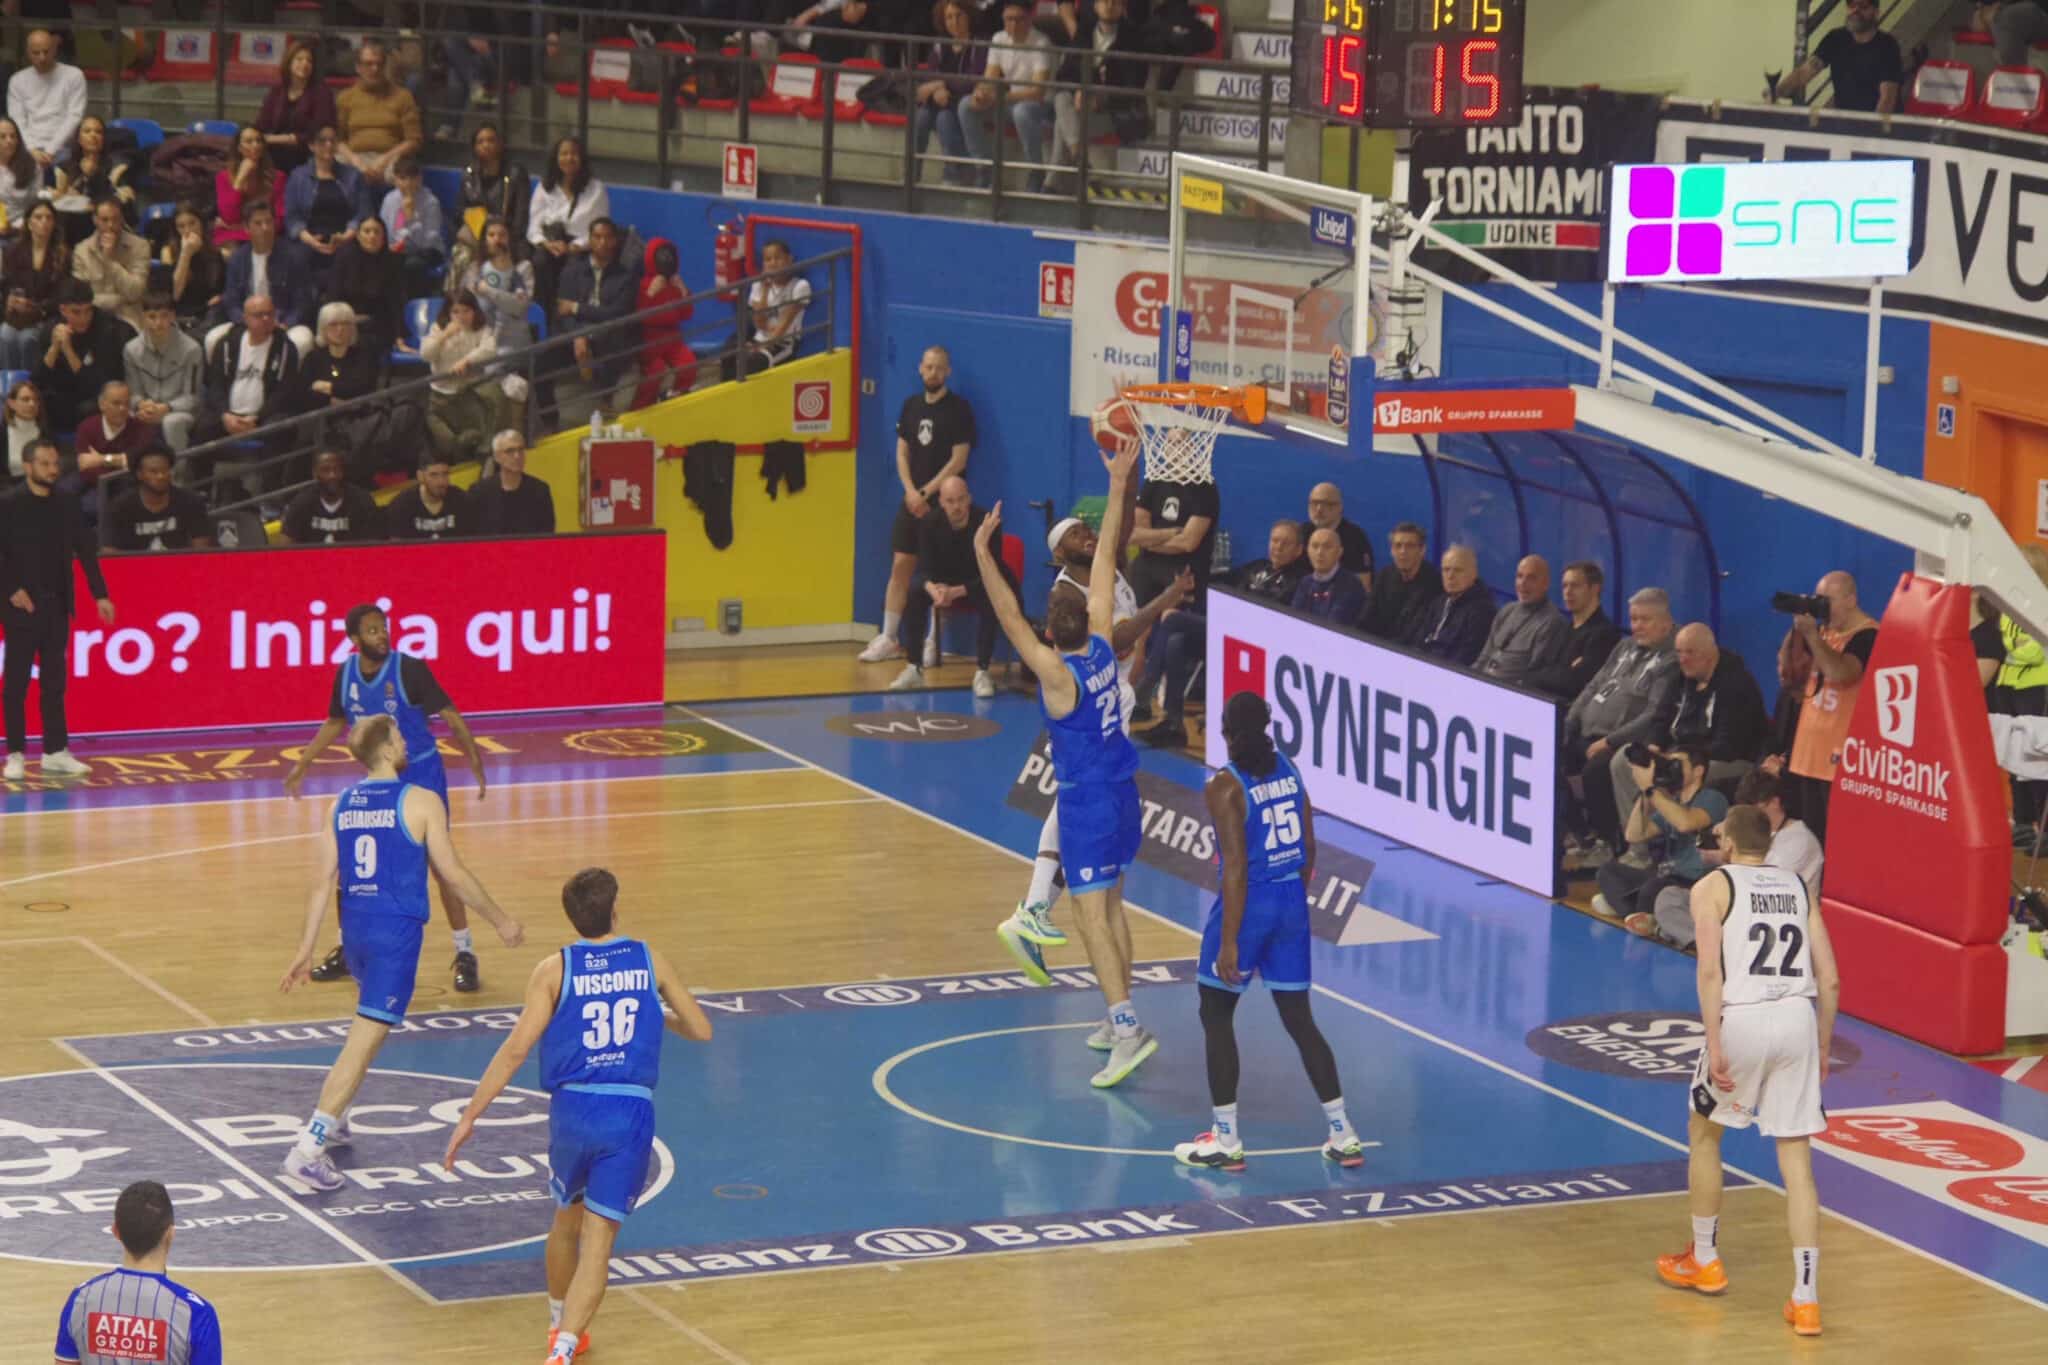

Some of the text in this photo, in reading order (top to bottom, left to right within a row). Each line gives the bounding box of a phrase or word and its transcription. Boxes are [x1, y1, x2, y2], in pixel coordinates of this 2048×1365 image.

[1323, 37, 1360, 115] 15
[1434, 41, 1498, 118] 15
[1422, 165, 1603, 215] TORNIAM
[1490, 222, 1552, 244] UDINE
[1132, 307, 1213, 335] CLA
[1401, 406, 1543, 425] Bank GRUPPO SPARKASSE
[70, 611, 201, 679] ro?
[466, 588, 612, 672] qui!
[1272, 654, 1533, 846] SYNERGIE
[1842, 736, 1951, 802] CiviBank
[1840, 777, 1948, 822] GRUPPO SPARKASSE
[354, 834, 377, 879] 9
[1748, 922, 1803, 977] 22
[572, 968, 649, 997] VISCONTI
[582, 997, 640, 1050] 36
[1546, 1024, 1697, 1075] ENERGY
[191, 1096, 551, 1147] BCC
[322, 1201, 416, 1217] BCC
[420, 1190, 553, 1209] ICCRE
[608, 1173, 1632, 1281] llianz Bank F.Zuliani
[95, 1335, 158, 1353] GROUP
[96, 1314, 158, 1340] ATTAL
